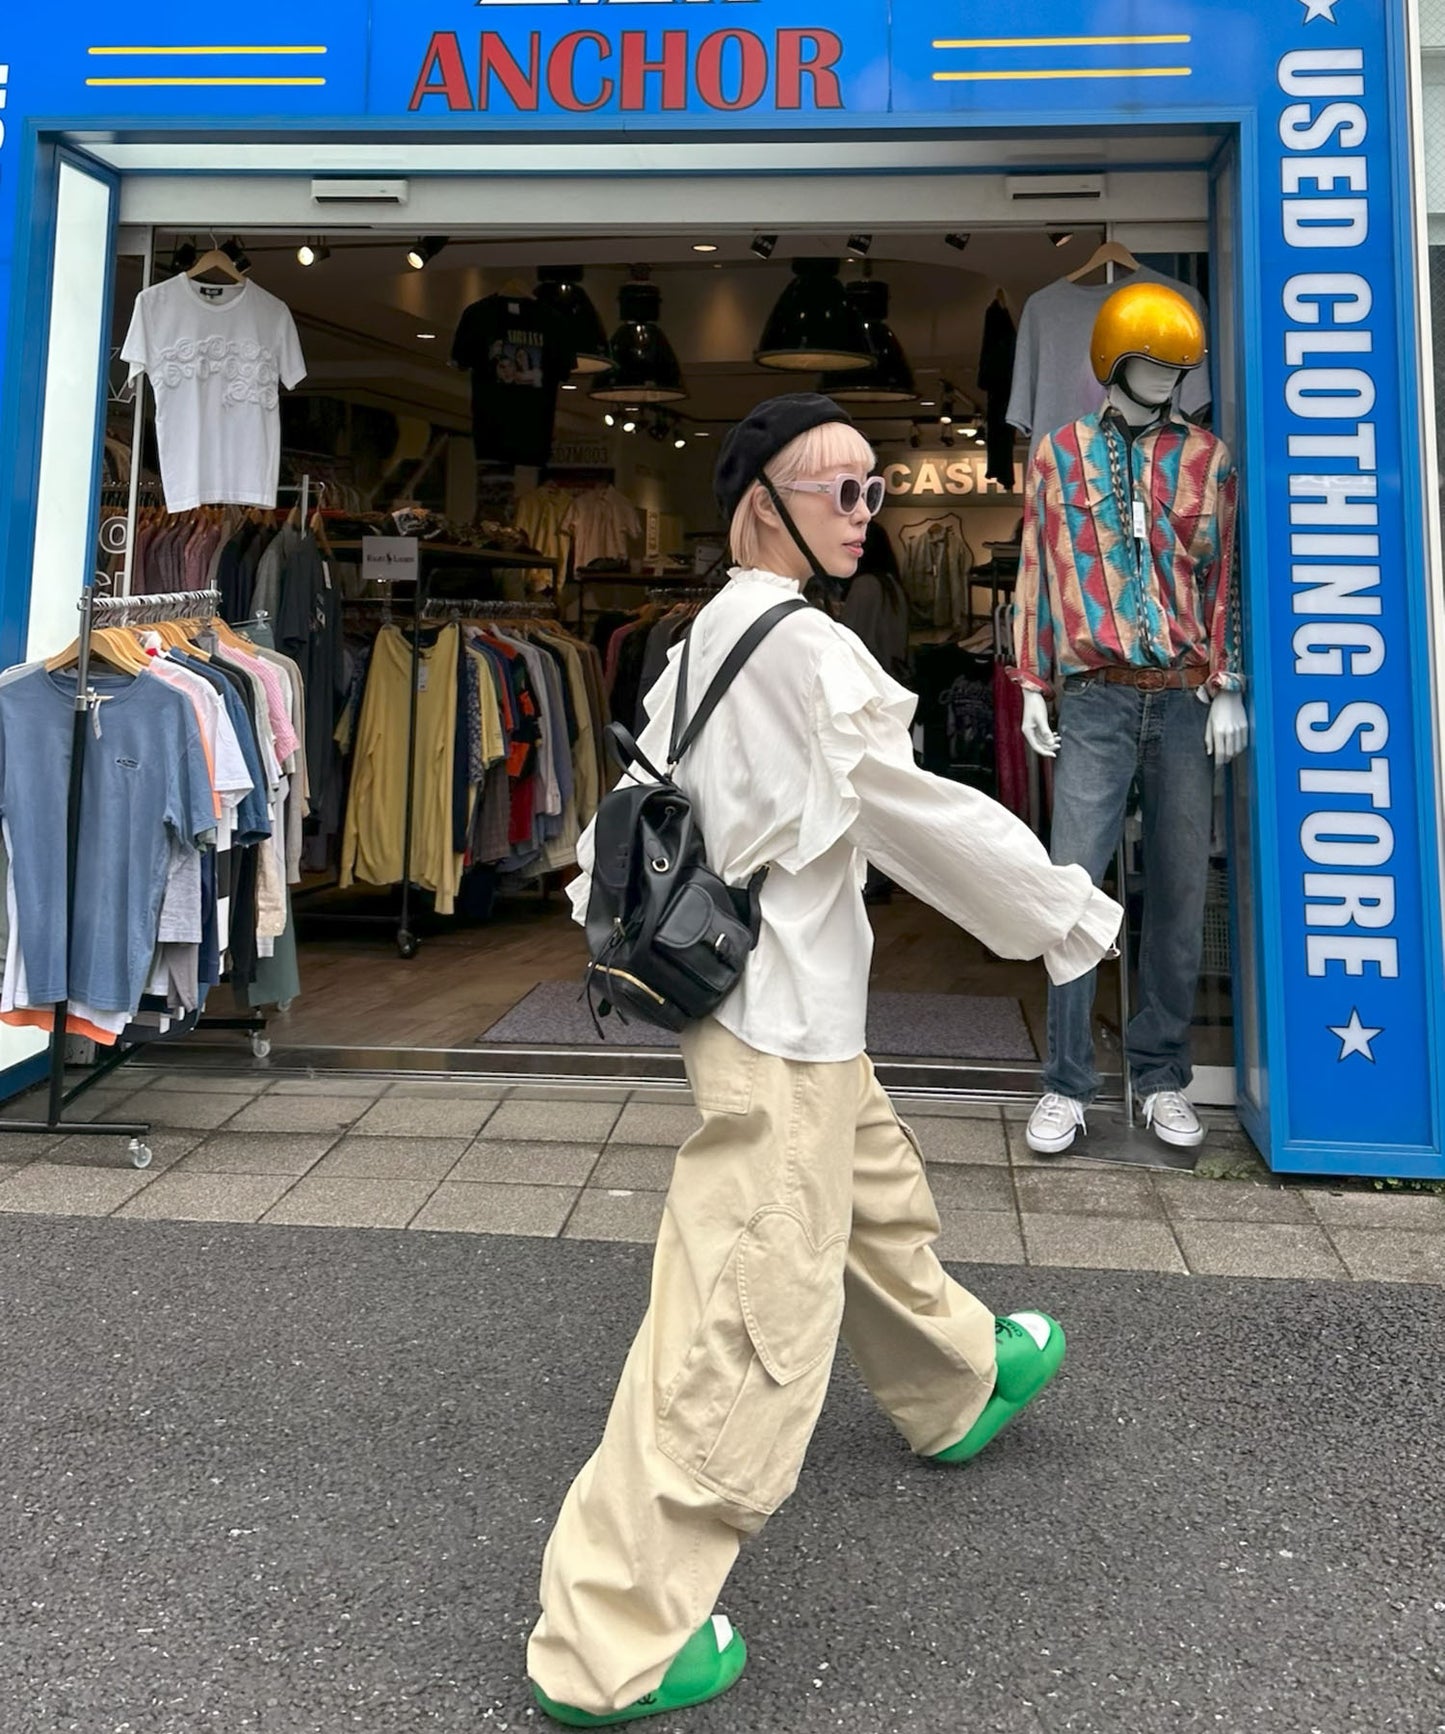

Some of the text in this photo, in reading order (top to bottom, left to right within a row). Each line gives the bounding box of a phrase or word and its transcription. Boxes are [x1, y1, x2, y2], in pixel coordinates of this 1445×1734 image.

[407, 27, 846, 112] ANCHOR
[1277, 48, 1399, 979] USED CLOTHING STORE
